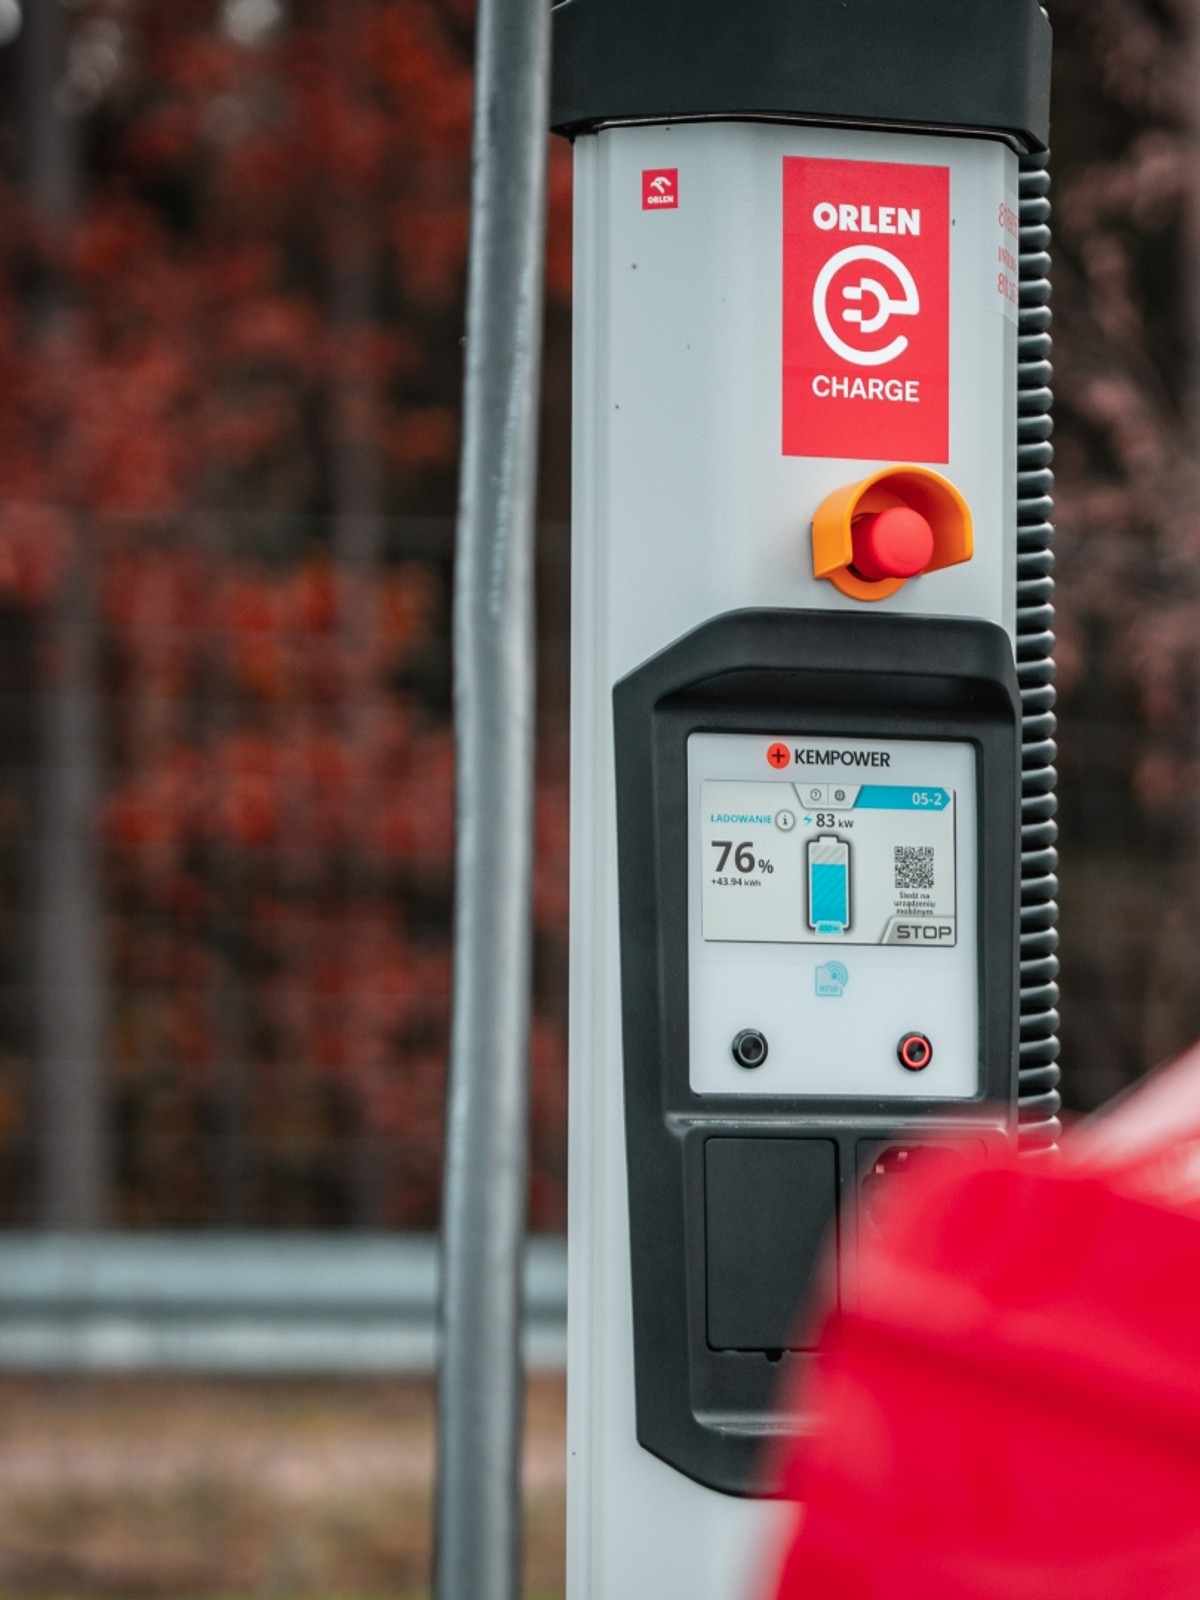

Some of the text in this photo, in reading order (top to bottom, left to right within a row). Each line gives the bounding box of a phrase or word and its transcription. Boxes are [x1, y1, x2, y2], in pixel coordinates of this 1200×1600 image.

[647, 195, 674, 204] ORLEN
[812, 202, 920, 236] ORLEN
[812, 375, 920, 402] CHARGE
[794, 749, 890, 767] KEMPOWER
[912, 792, 942, 806] 05-2
[816, 813, 854, 829] 83 kW
[897, 925, 952, 939] STOP
